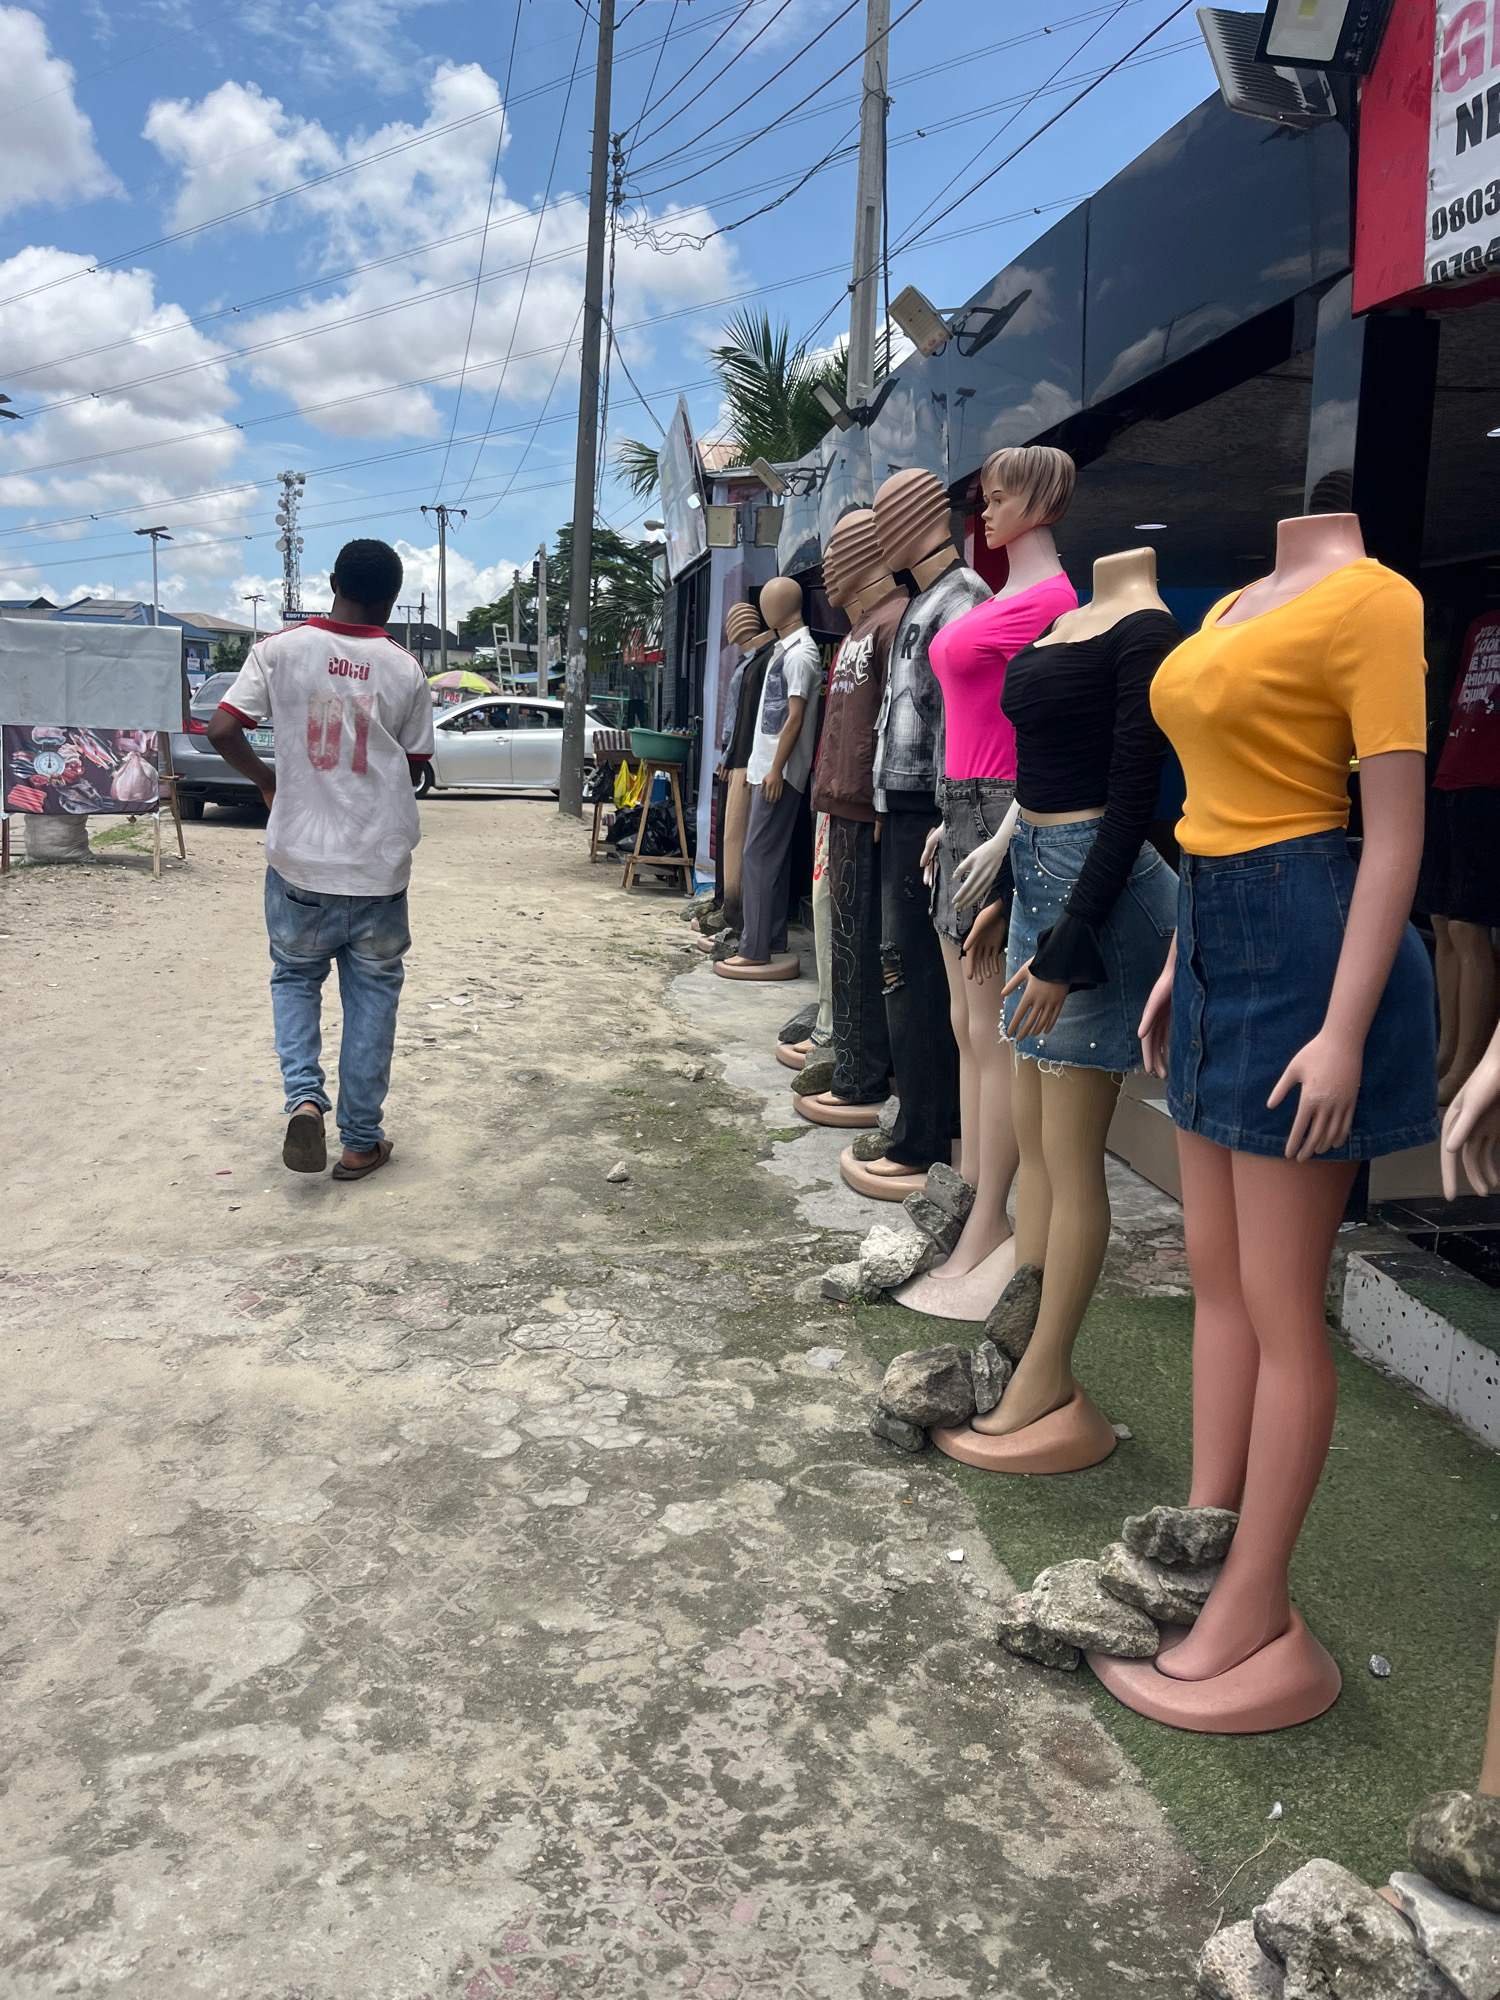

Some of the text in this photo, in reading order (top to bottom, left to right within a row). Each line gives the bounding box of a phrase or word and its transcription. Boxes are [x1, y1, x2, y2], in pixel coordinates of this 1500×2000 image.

[1441, 0, 1500, 93] G
[1432, 178, 1500, 240] 0803
[901, 623, 921, 660] R
[444, 691, 461, 703] POS
[307, 689, 375, 774] 01
